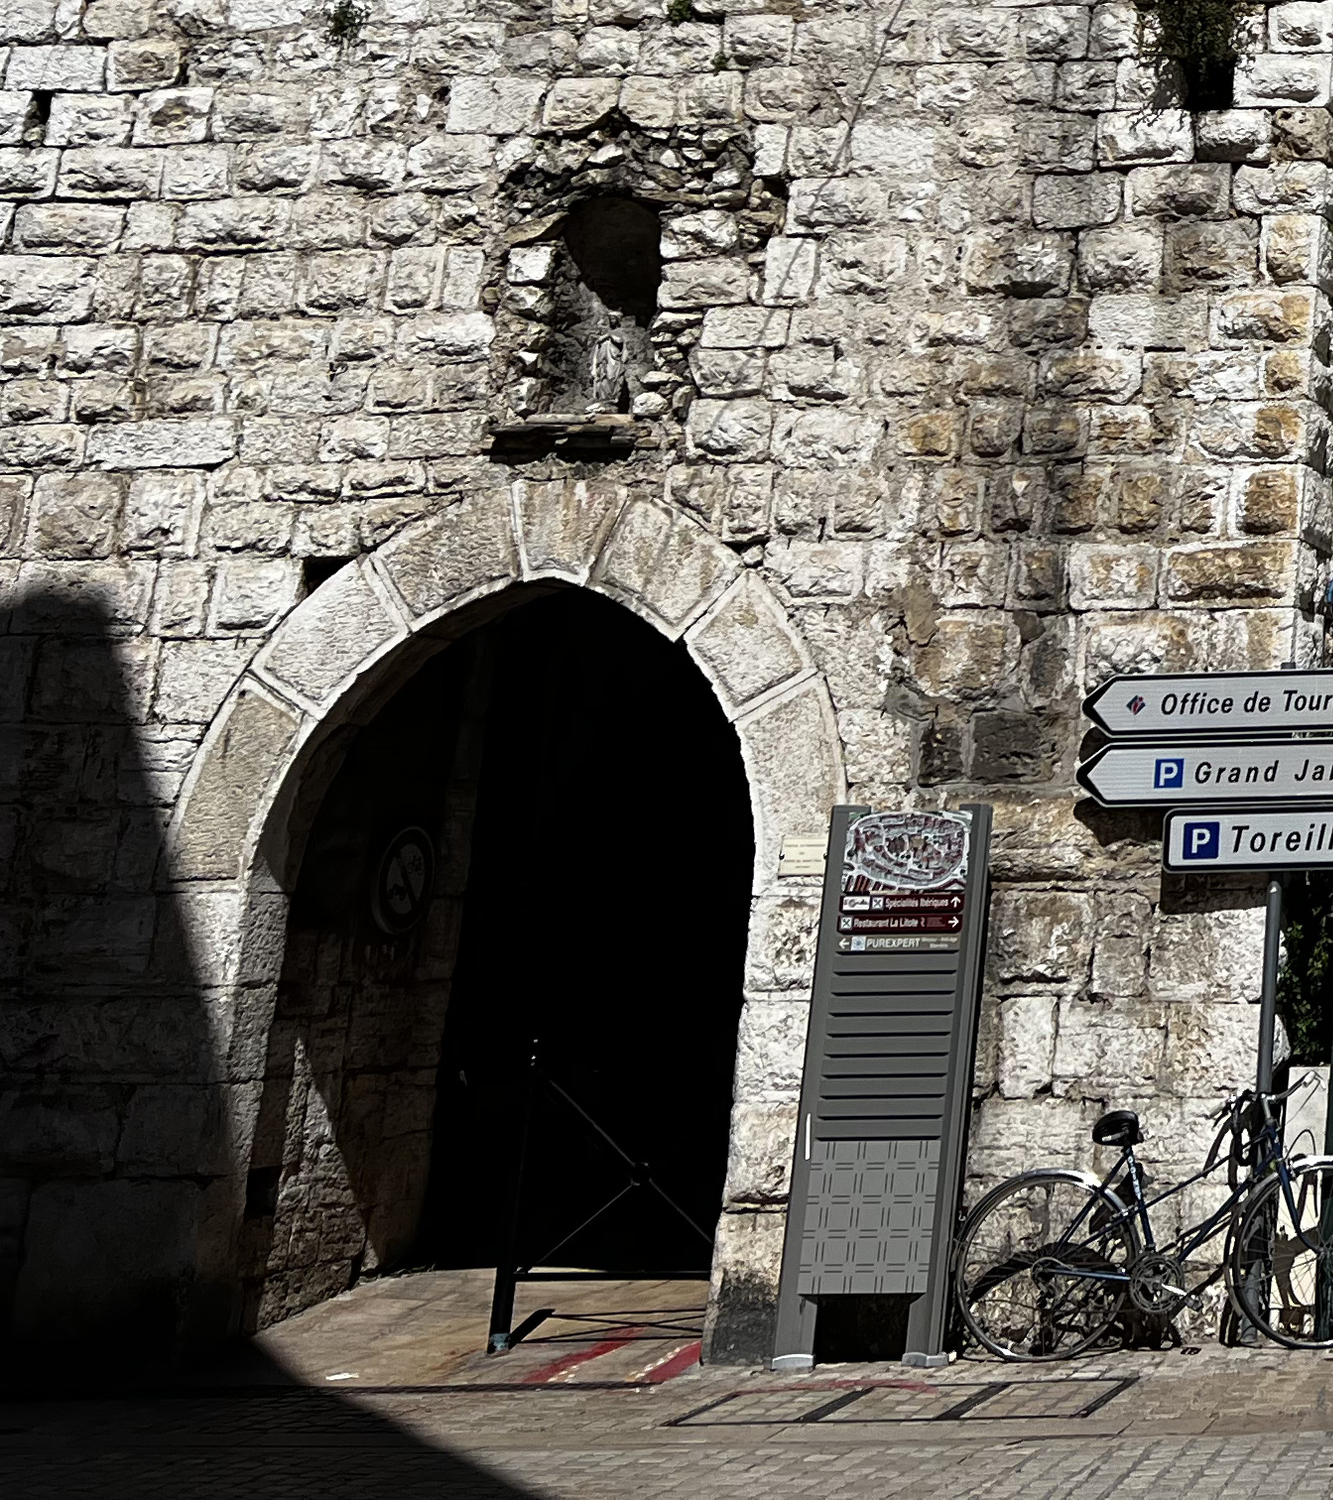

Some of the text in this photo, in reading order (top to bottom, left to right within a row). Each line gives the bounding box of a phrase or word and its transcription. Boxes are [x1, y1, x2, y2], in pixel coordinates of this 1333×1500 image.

[1160, 692, 1234, 715] Office
[1243, 691, 1271, 713] de
[1195, 760, 1280, 784] Grand
[866, 937, 921, 949] PUREXPERT
